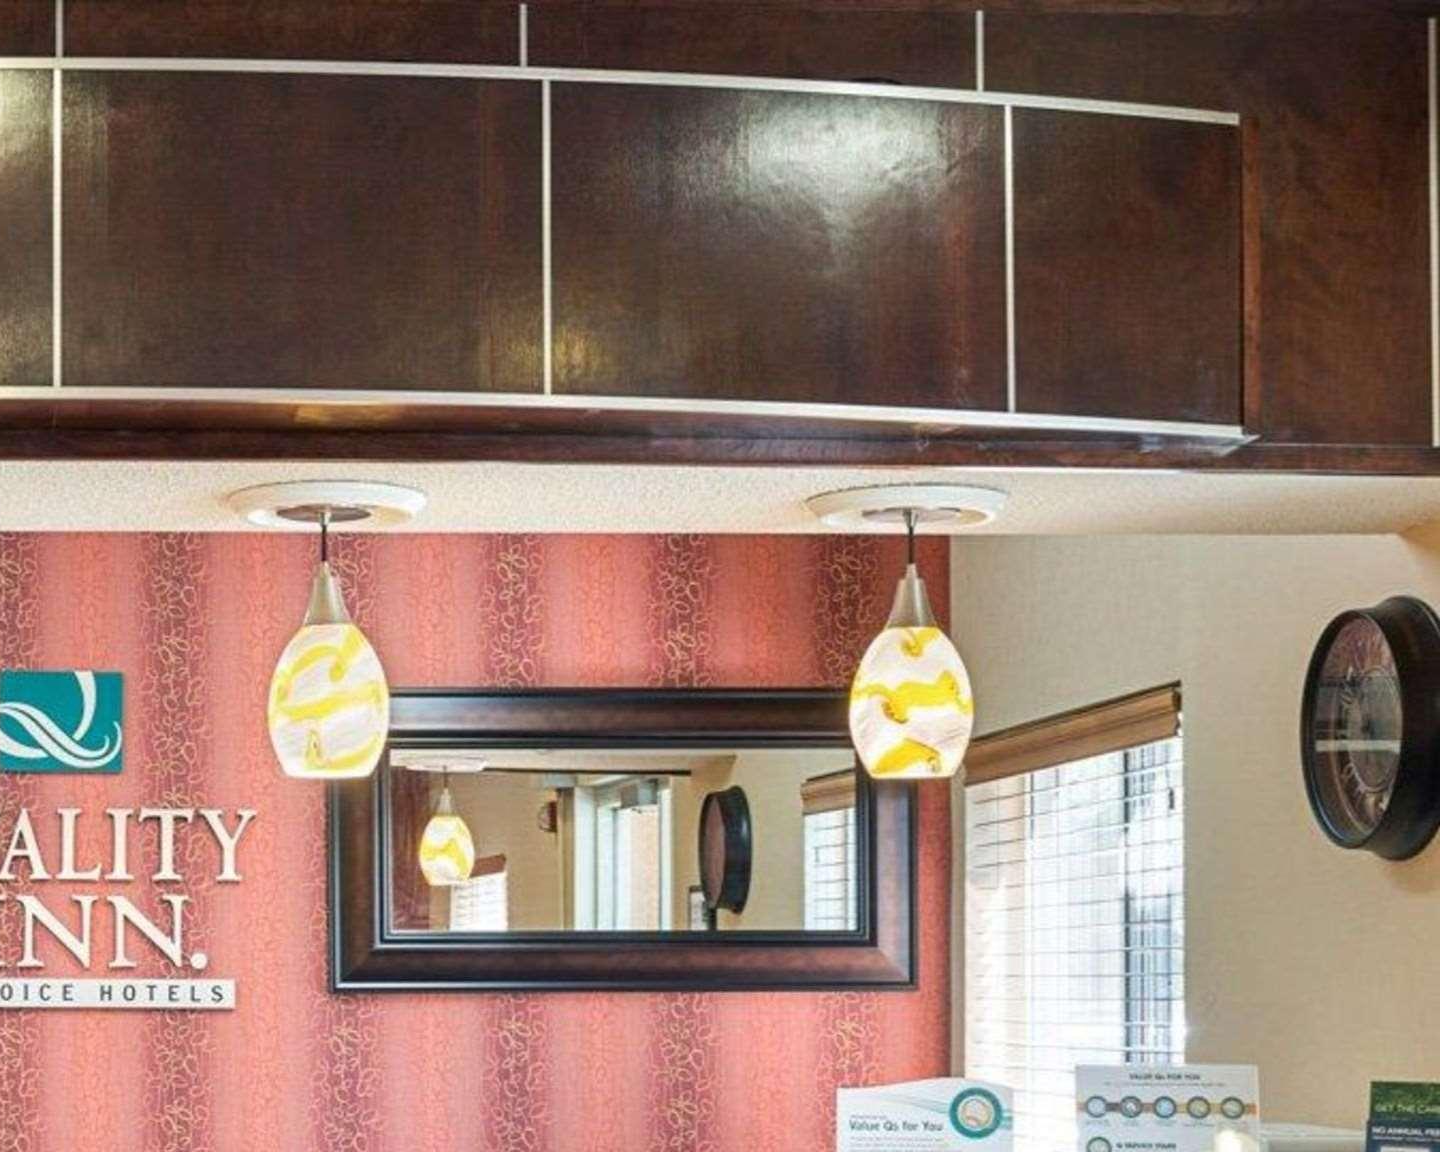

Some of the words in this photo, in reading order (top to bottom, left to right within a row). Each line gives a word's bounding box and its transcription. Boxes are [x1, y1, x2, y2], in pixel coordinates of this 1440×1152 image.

[99, 984, 226, 1003] HOTELS
[849, 1119, 880, 1132] Value
[902, 1119, 919, 1131] for
[921, 1120, 944, 1132] You
